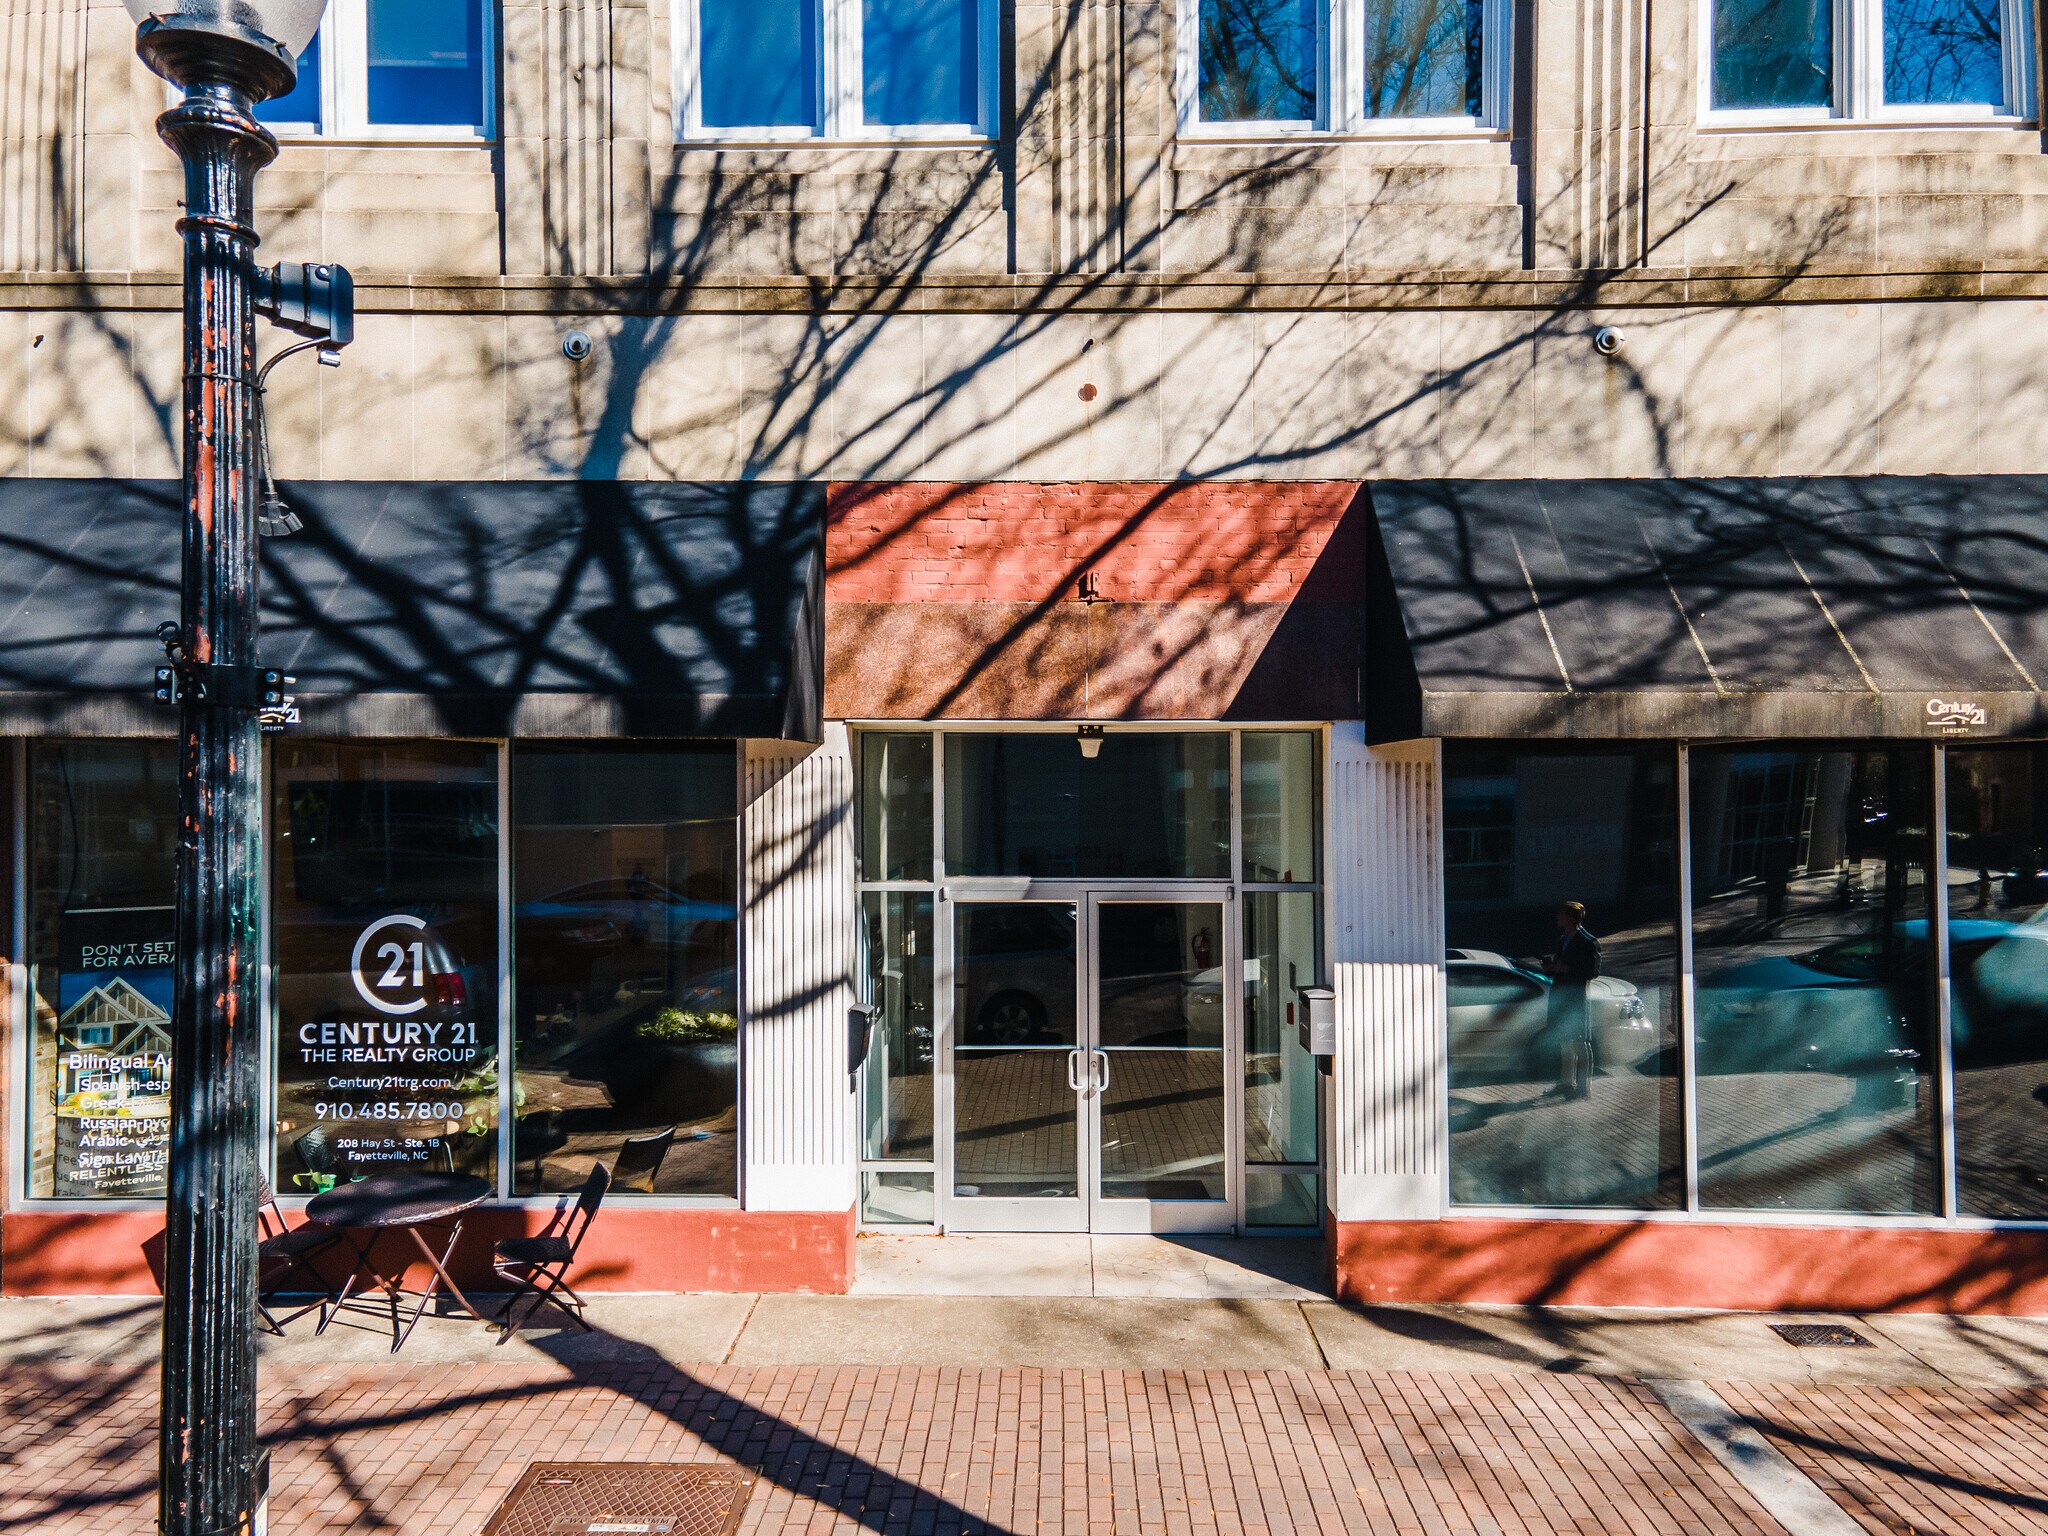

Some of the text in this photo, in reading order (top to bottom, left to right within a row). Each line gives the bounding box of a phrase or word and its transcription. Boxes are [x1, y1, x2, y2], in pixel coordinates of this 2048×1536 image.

[1926, 698, 1985, 725] Century 21
[82, 943, 138, 957] DON'T
[82, 957, 118, 968] FOR
[299, 1022, 443, 1044] CENTURY
[301, 1047, 476, 1063] THE REALTY GROUP
[69, 1053, 148, 1074] Bilingual
[80, 1078, 170, 1093] Spansh-esp
[328, 1076, 451, 1091] Century21trg.com
[315, 1102, 464, 1120] 910.485.7800
[337, 1138, 359, 1148] 208
[361, 1139, 380, 1149] Hay
[383, 1139, 395, 1148] St
[404, 1139, 425, 1148] Ste.
[427, 1139, 440, 1148] 1B
[348, 1151, 429, 1162] Fayetteville, NC
[69, 1163, 164, 1182] RELENTLESS
[94, 1174, 164, 1190] Fayetteville,
